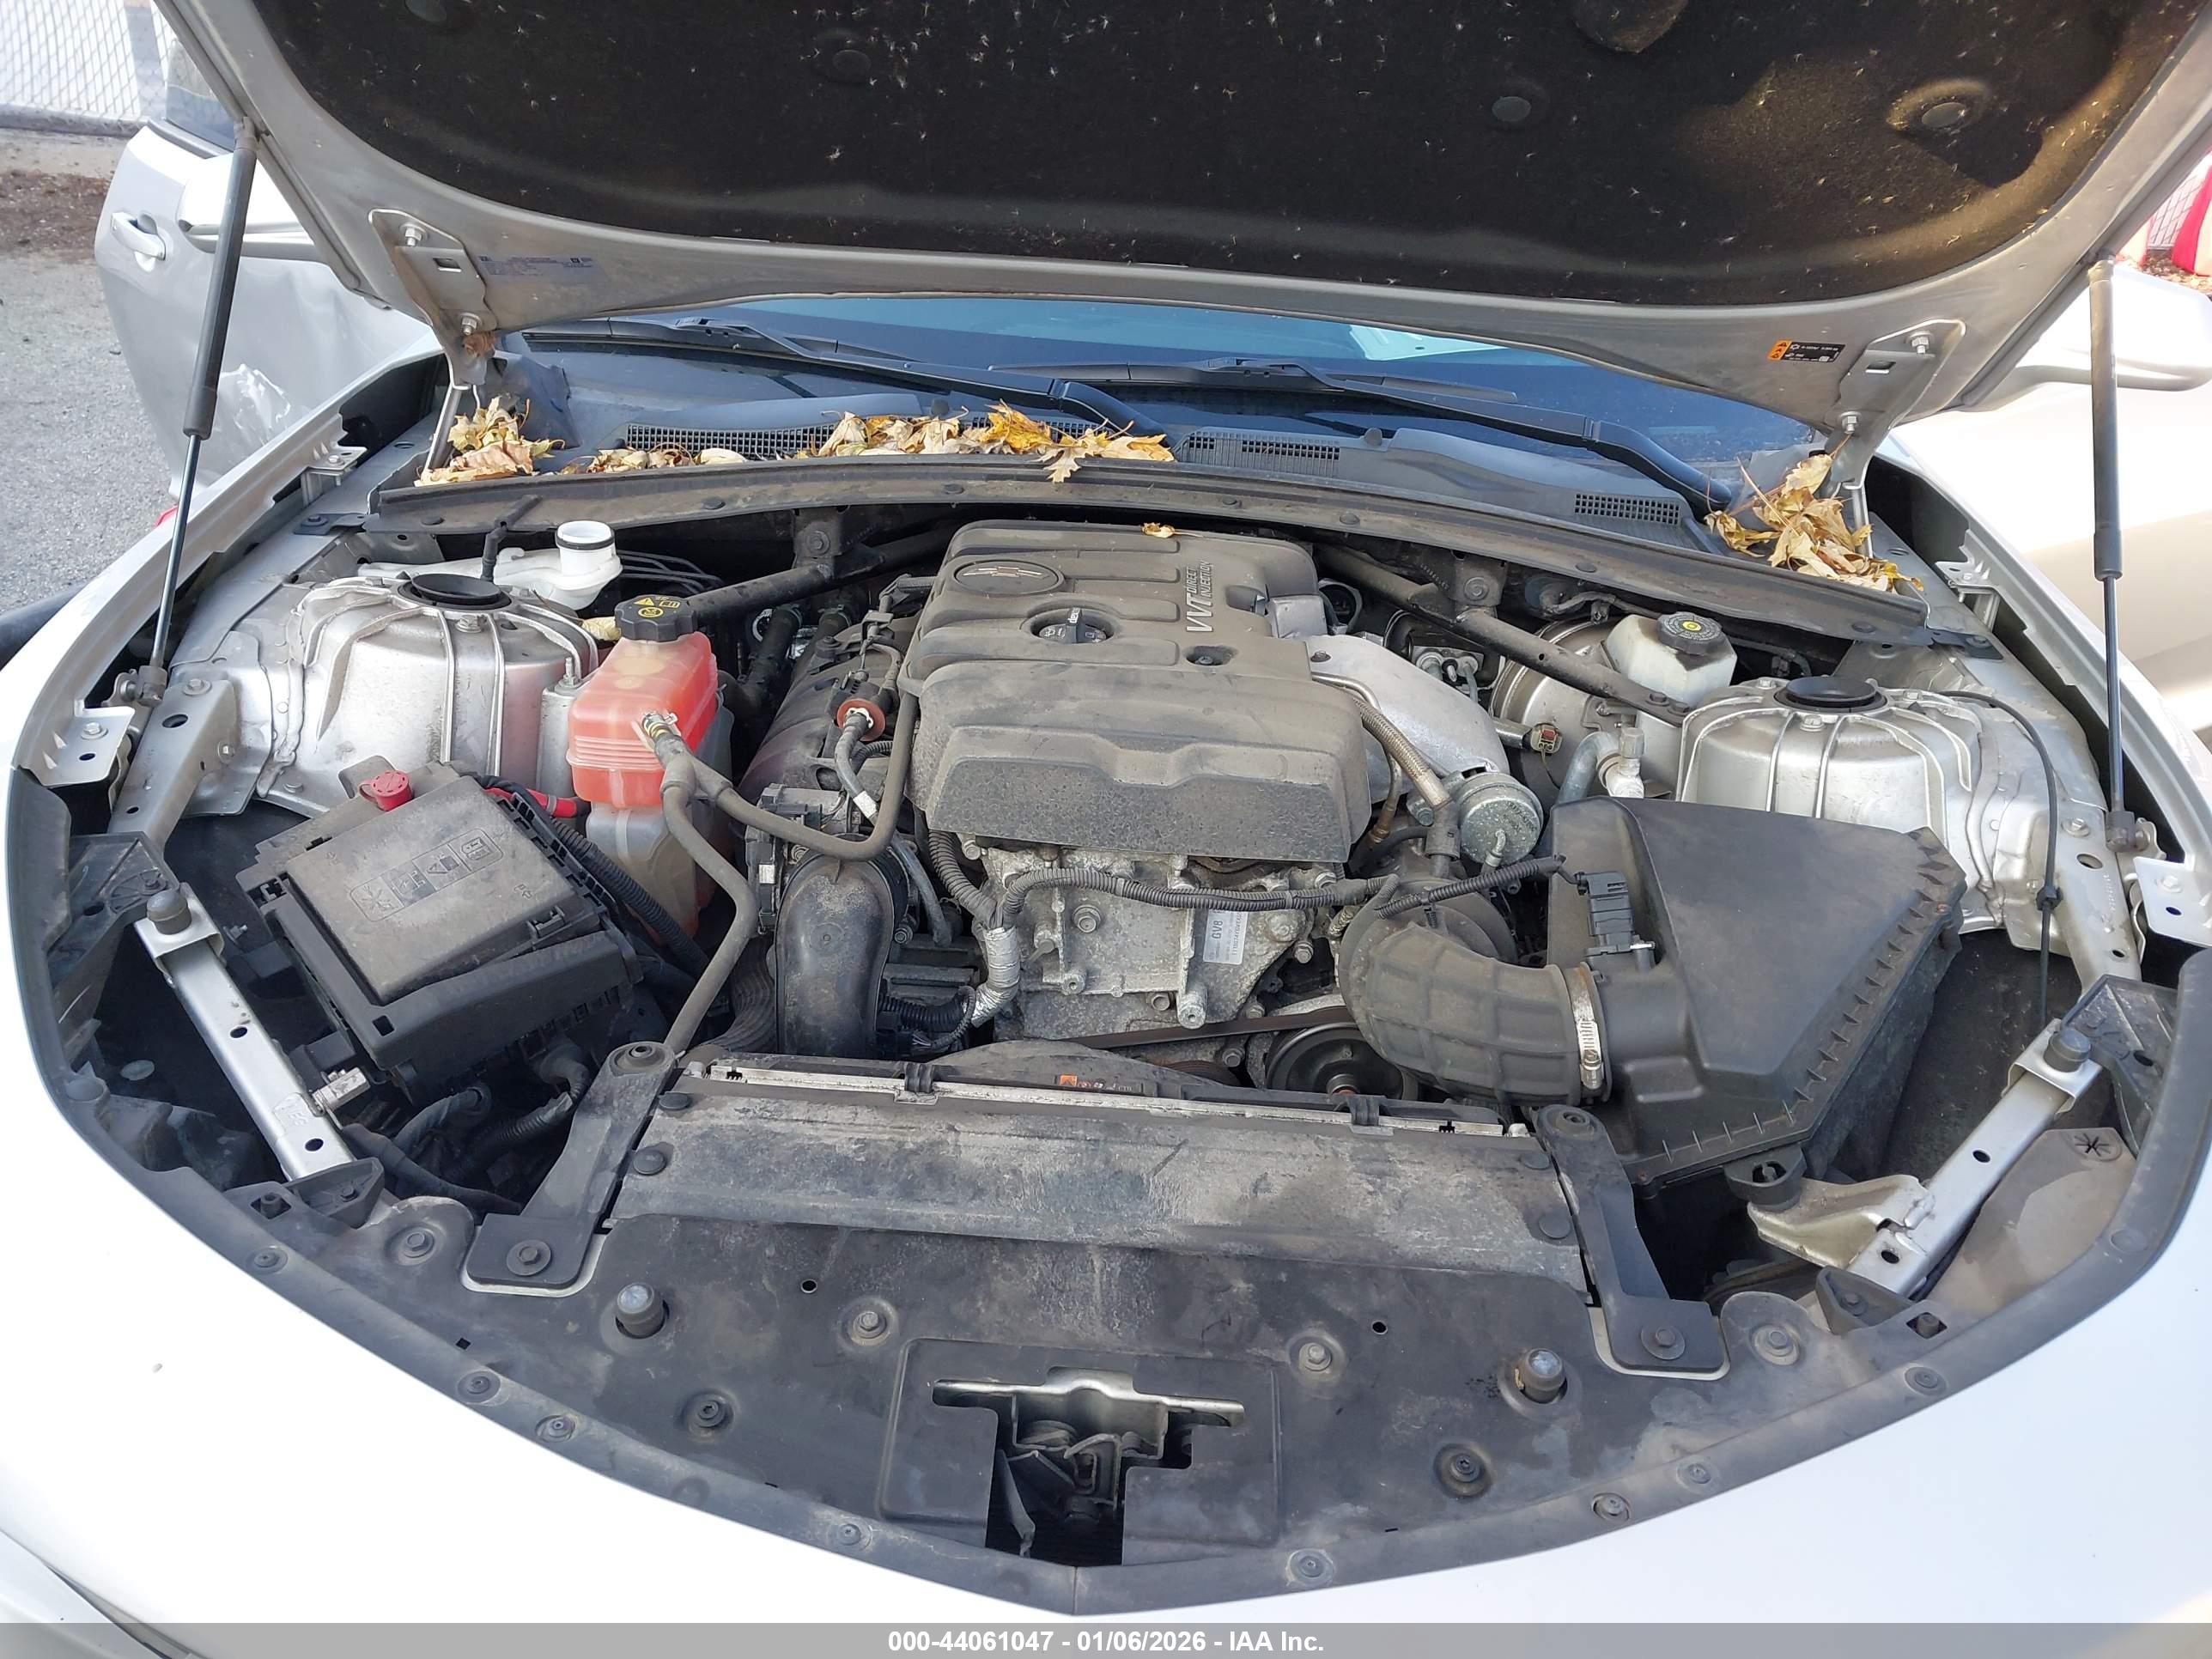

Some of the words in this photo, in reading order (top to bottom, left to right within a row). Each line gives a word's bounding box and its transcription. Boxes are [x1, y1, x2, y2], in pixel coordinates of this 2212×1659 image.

[1185, 565, 1198, 594] DIRECT
[1199, 558, 1213, 598] INJECTION
[1186, 592, 1212, 632] VVT
[1212, 920, 1224, 939] GV8
